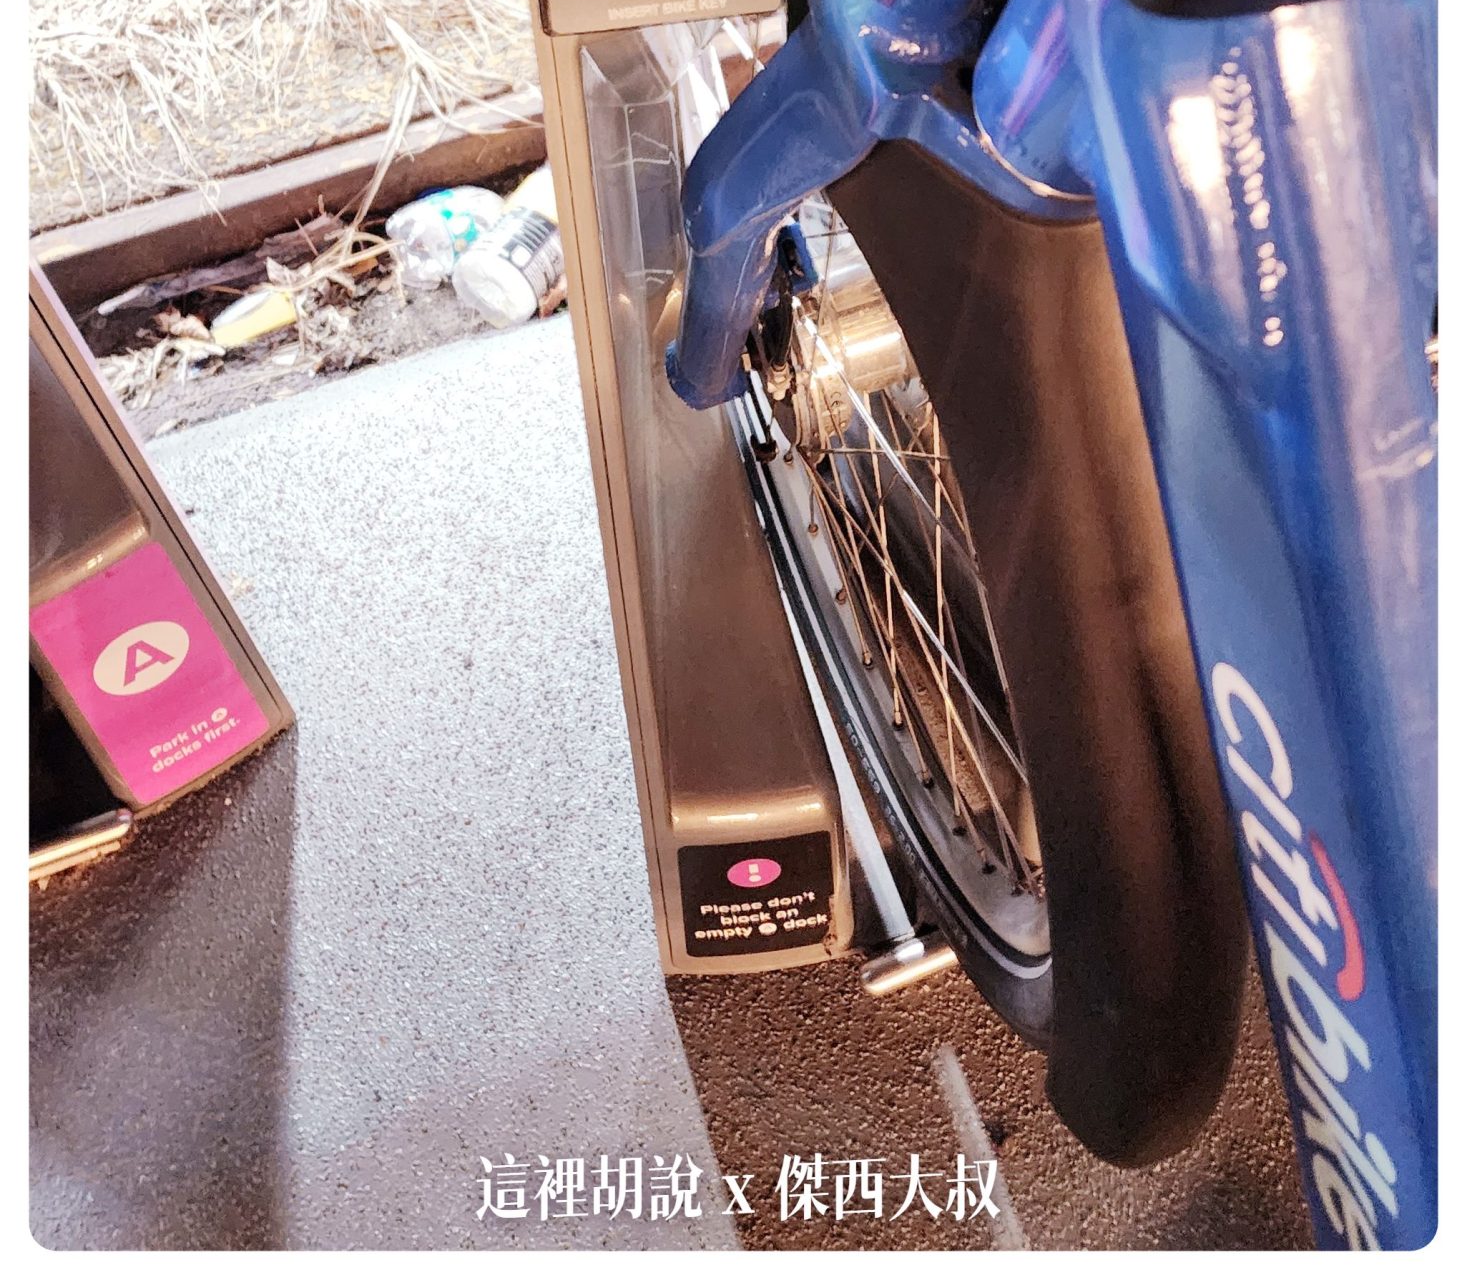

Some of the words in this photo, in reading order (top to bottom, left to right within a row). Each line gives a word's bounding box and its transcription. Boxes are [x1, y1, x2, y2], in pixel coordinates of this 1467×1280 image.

[607, 3, 660, 21] INSERT
[662, 0, 696, 15] BIKE
[123, 639, 175, 688] A
[149, 731, 189, 759] Park
[190, 720, 209, 735] in
[152, 740, 202, 773] docks
[700, 899, 763, 915] Please
[767, 891, 816, 909] don't
[720, 911, 771, 927] block
[775, 907, 799, 920] an
[694, 925, 753, 941] empty
[783, 913, 828, 931] dock
